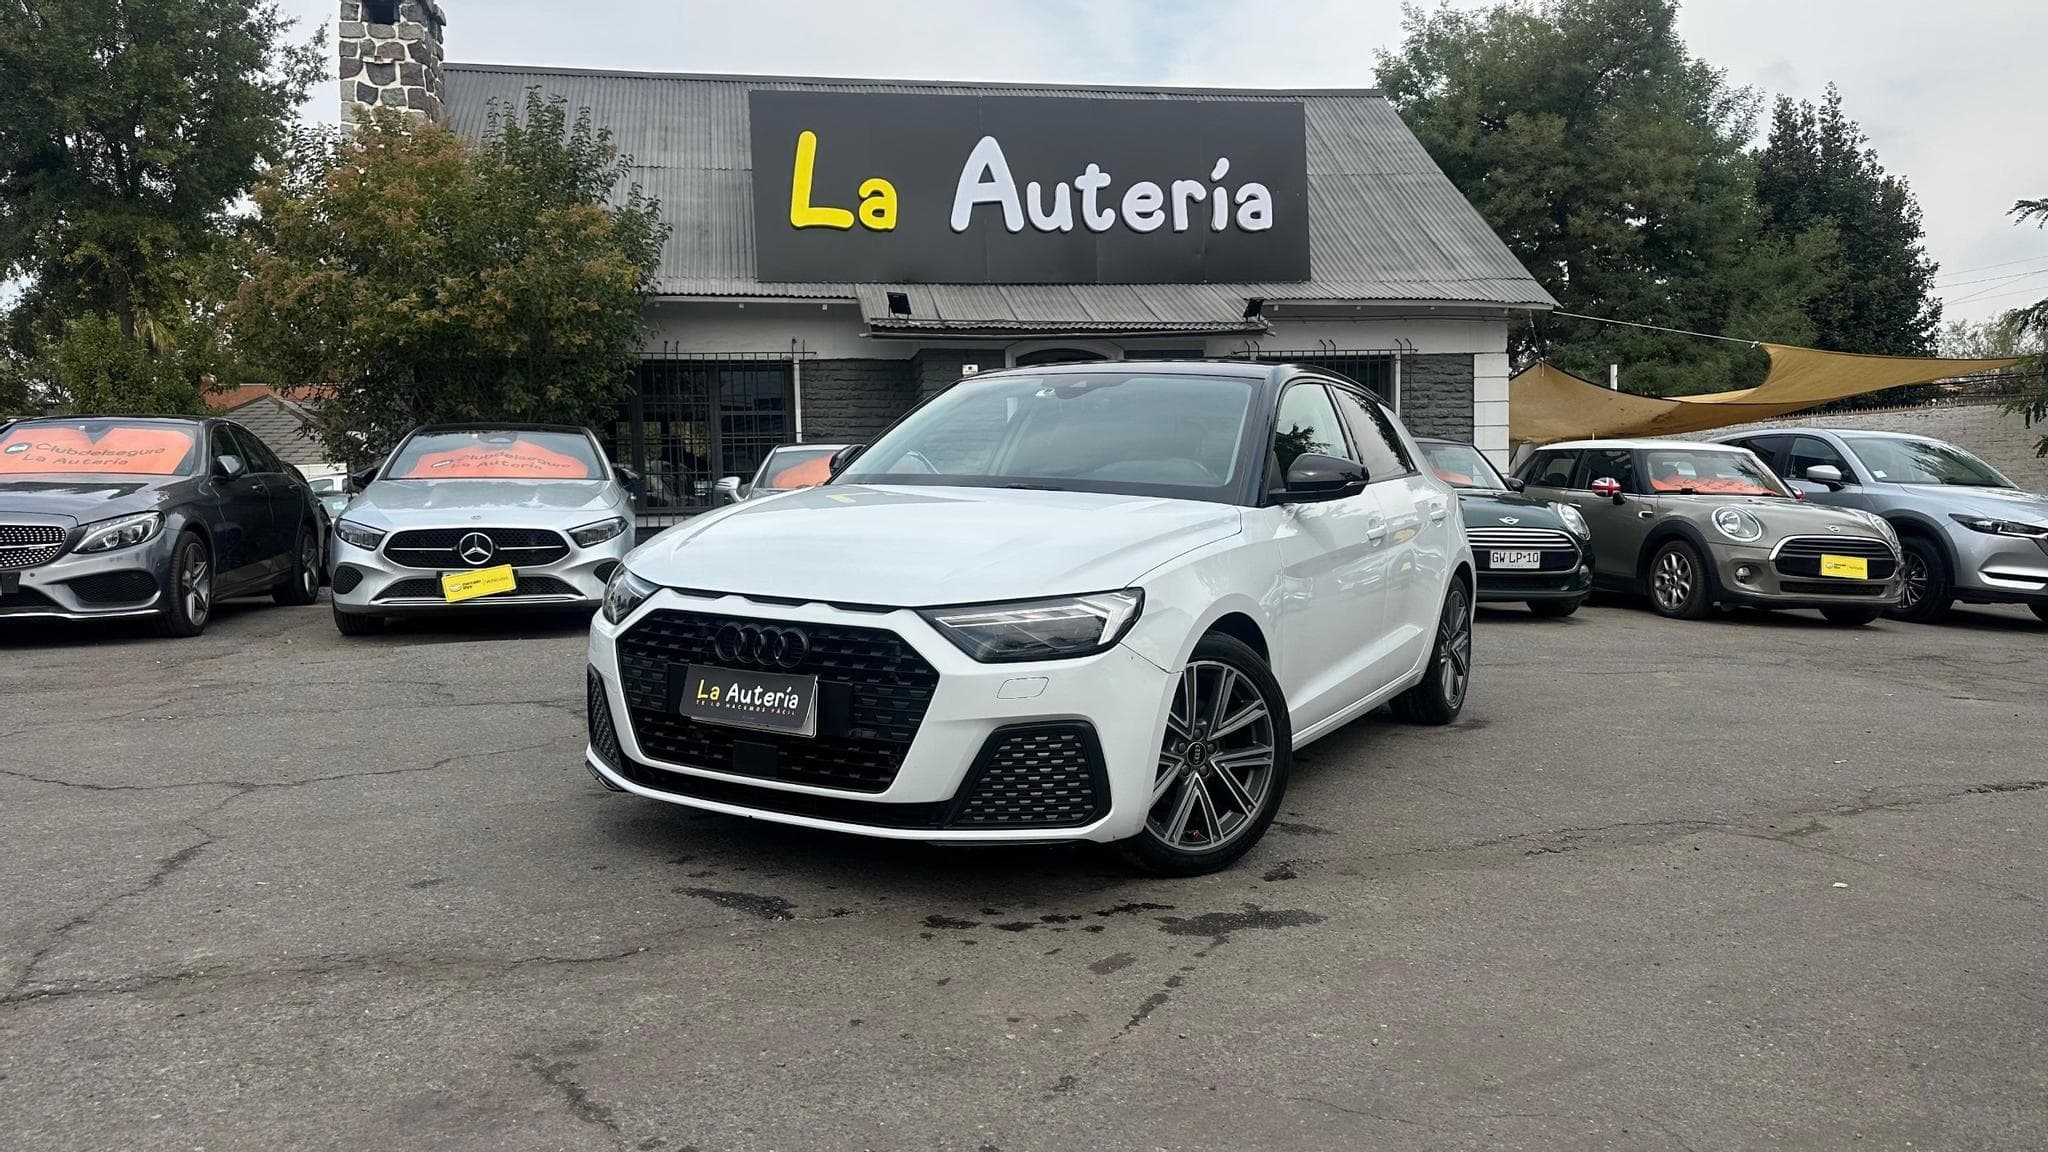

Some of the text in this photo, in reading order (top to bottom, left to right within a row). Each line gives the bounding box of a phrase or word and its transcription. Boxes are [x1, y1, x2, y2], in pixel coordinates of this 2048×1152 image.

[790, 130, 1273, 233] La Autería
[22, 454, 47, 462] La
[697, 679, 799, 709] La Autería
